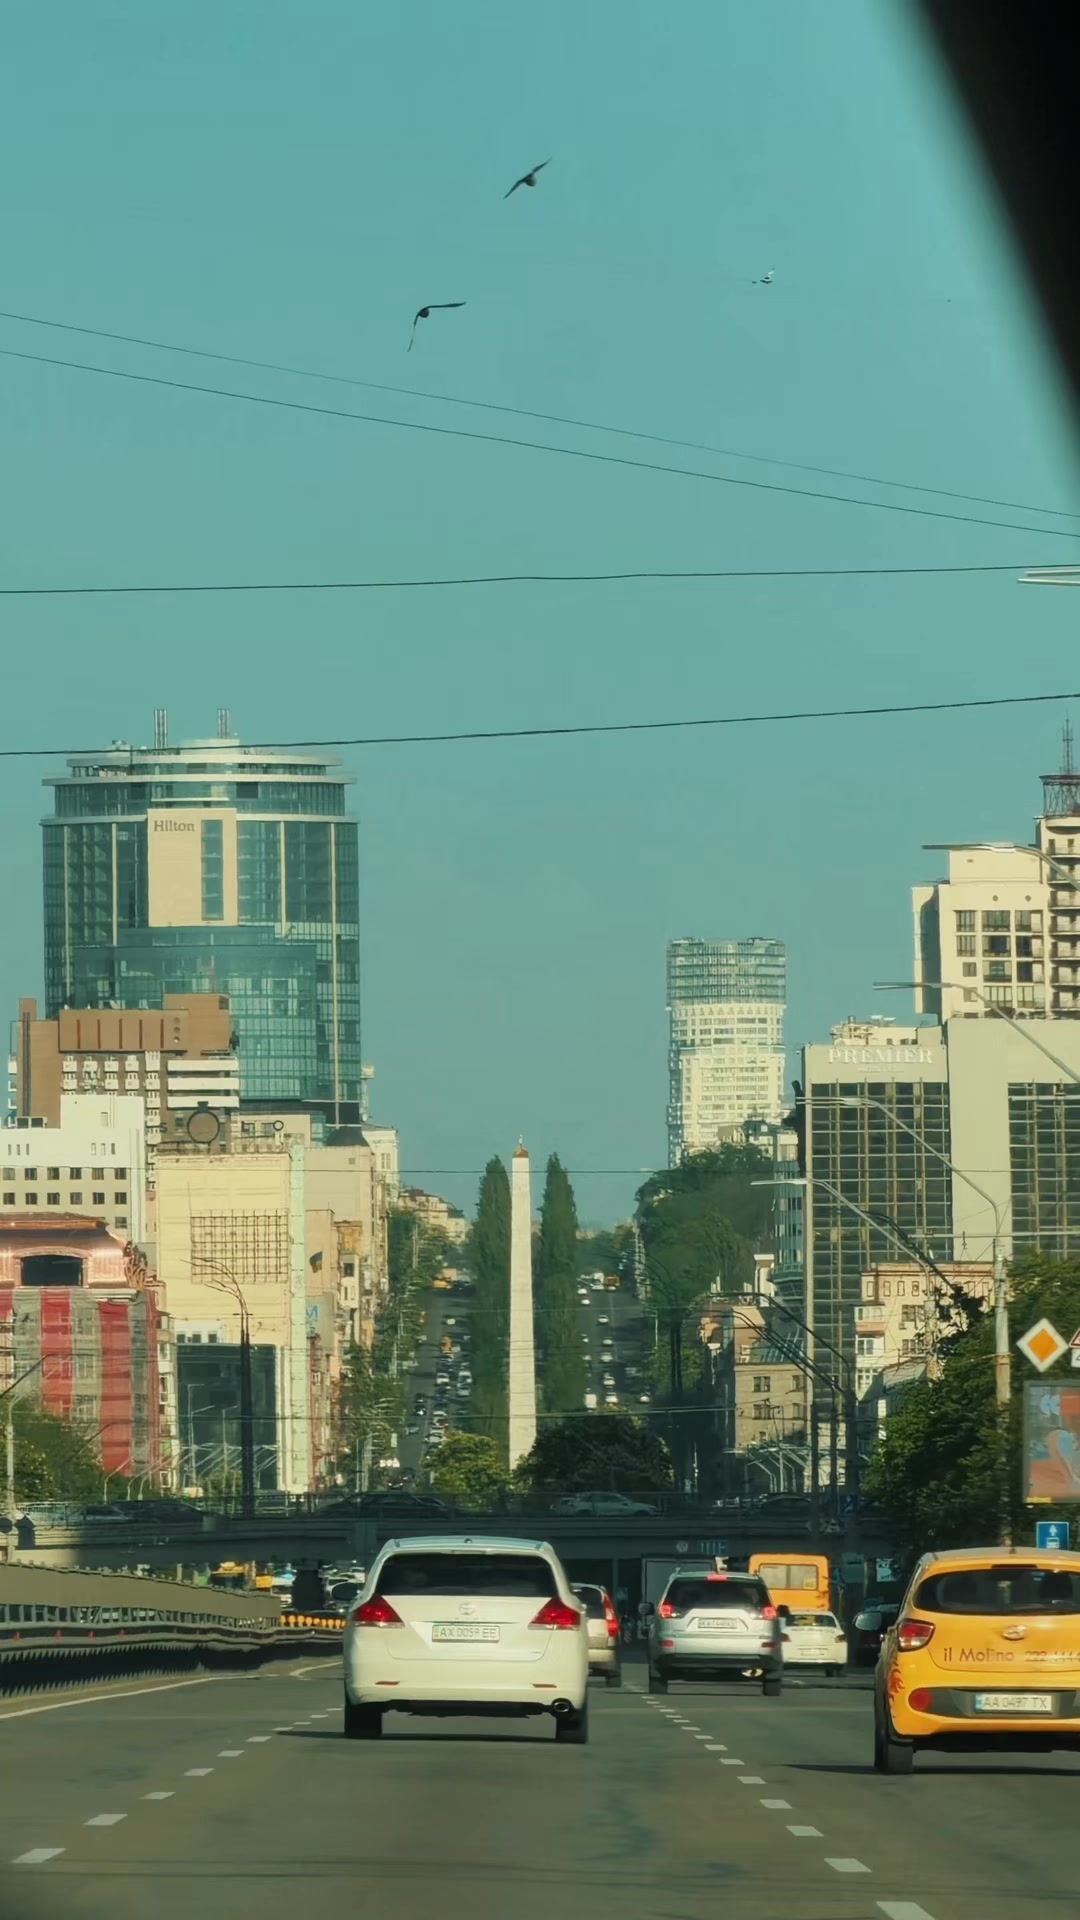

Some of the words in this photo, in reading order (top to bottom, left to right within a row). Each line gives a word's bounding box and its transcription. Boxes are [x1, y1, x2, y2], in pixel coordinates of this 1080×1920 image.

[154, 819, 195, 832] Hilton
[828, 1048, 933, 1064] PREMIER
[482, 1627, 497, 1639] EE
[943, 1647, 952, 1662] il
[959, 1648, 1015, 1662] Molino
